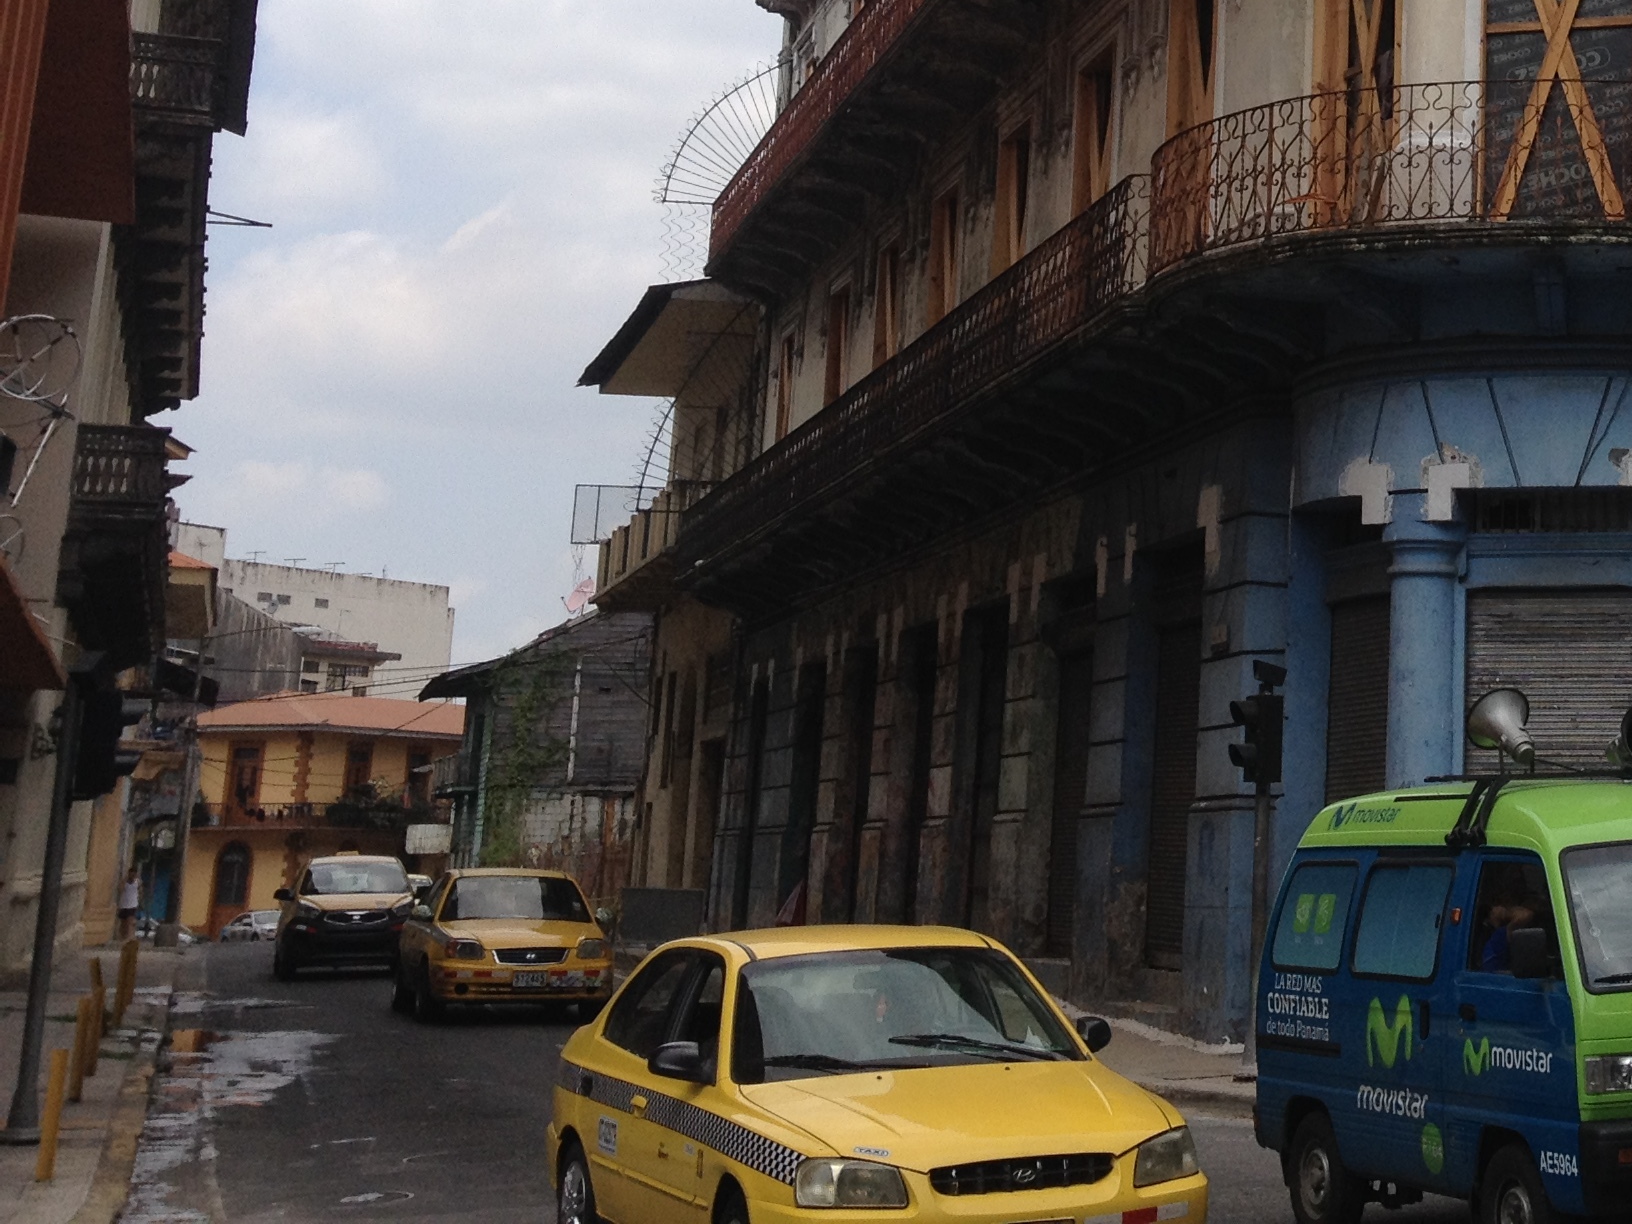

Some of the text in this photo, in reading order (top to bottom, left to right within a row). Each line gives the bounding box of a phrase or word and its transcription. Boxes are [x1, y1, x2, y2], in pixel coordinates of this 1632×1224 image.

[1353, 807, 1401, 823] movistar
[1274, 973, 1323, 994] LA RED MAS
[1267, 992, 1330, 1019] CONFIABLE
[1266, 1016, 1330, 1042] de todo Panamá
[1491, 1046, 1553, 1073] movistar
[1357, 1084, 1429, 1118] movistar
[1540, 1150, 1578, 1177] AE5964
